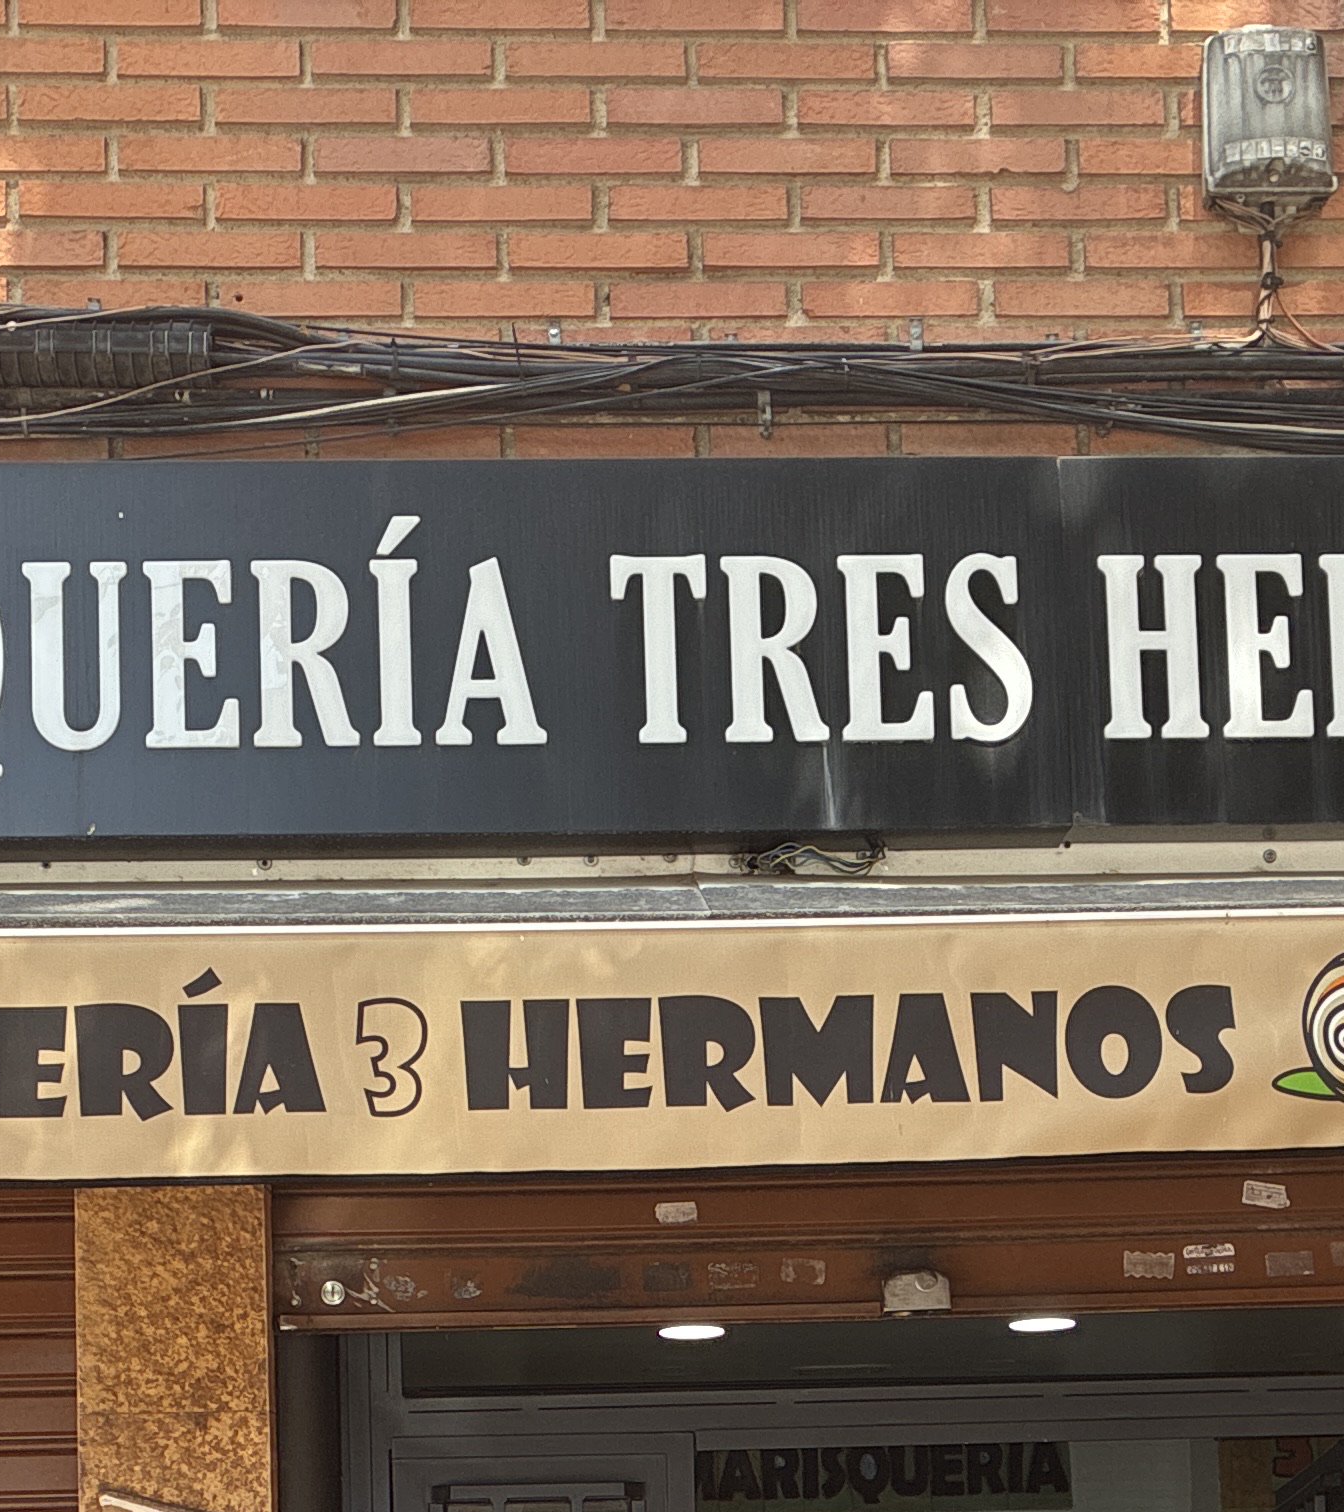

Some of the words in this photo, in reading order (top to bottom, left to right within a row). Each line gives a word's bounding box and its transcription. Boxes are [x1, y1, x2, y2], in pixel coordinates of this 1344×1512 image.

[608, 551, 1034, 745] TRES
[354, 996, 429, 1119] 3
[458, 983, 1237, 1114] HERMANOS
